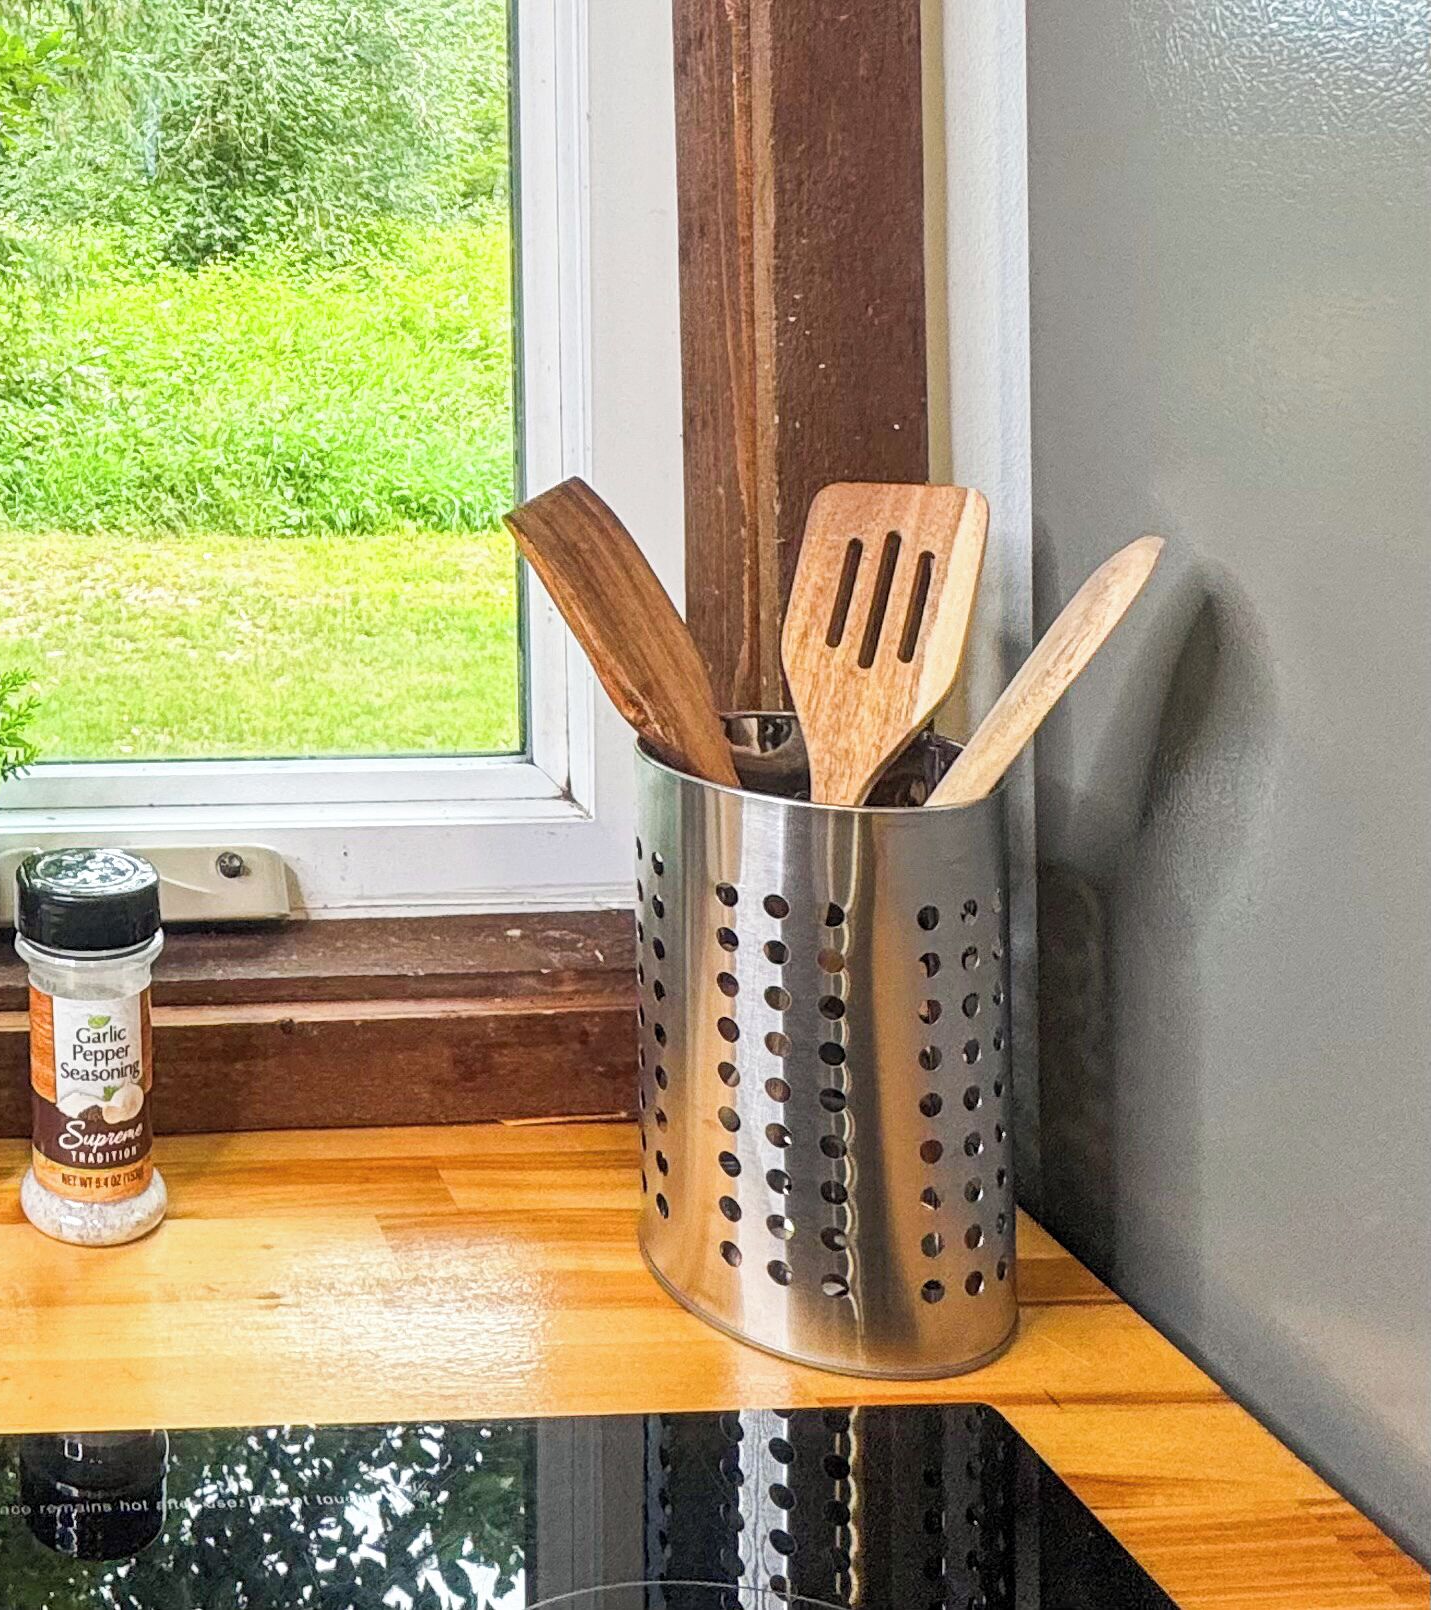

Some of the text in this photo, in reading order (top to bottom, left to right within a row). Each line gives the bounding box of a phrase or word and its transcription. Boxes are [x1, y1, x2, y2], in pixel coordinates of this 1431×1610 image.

[75, 1025, 127, 1044] Garlic
[72, 1044, 131, 1067] Pepper
[60, 1059, 141, 1082] Seasoning
[58, 1120, 144, 1153] Supreme
[70, 1145, 137, 1164] TRADITION
[39, 1500, 112, 1515] remains
[119, 1499, 149, 1512] hot
